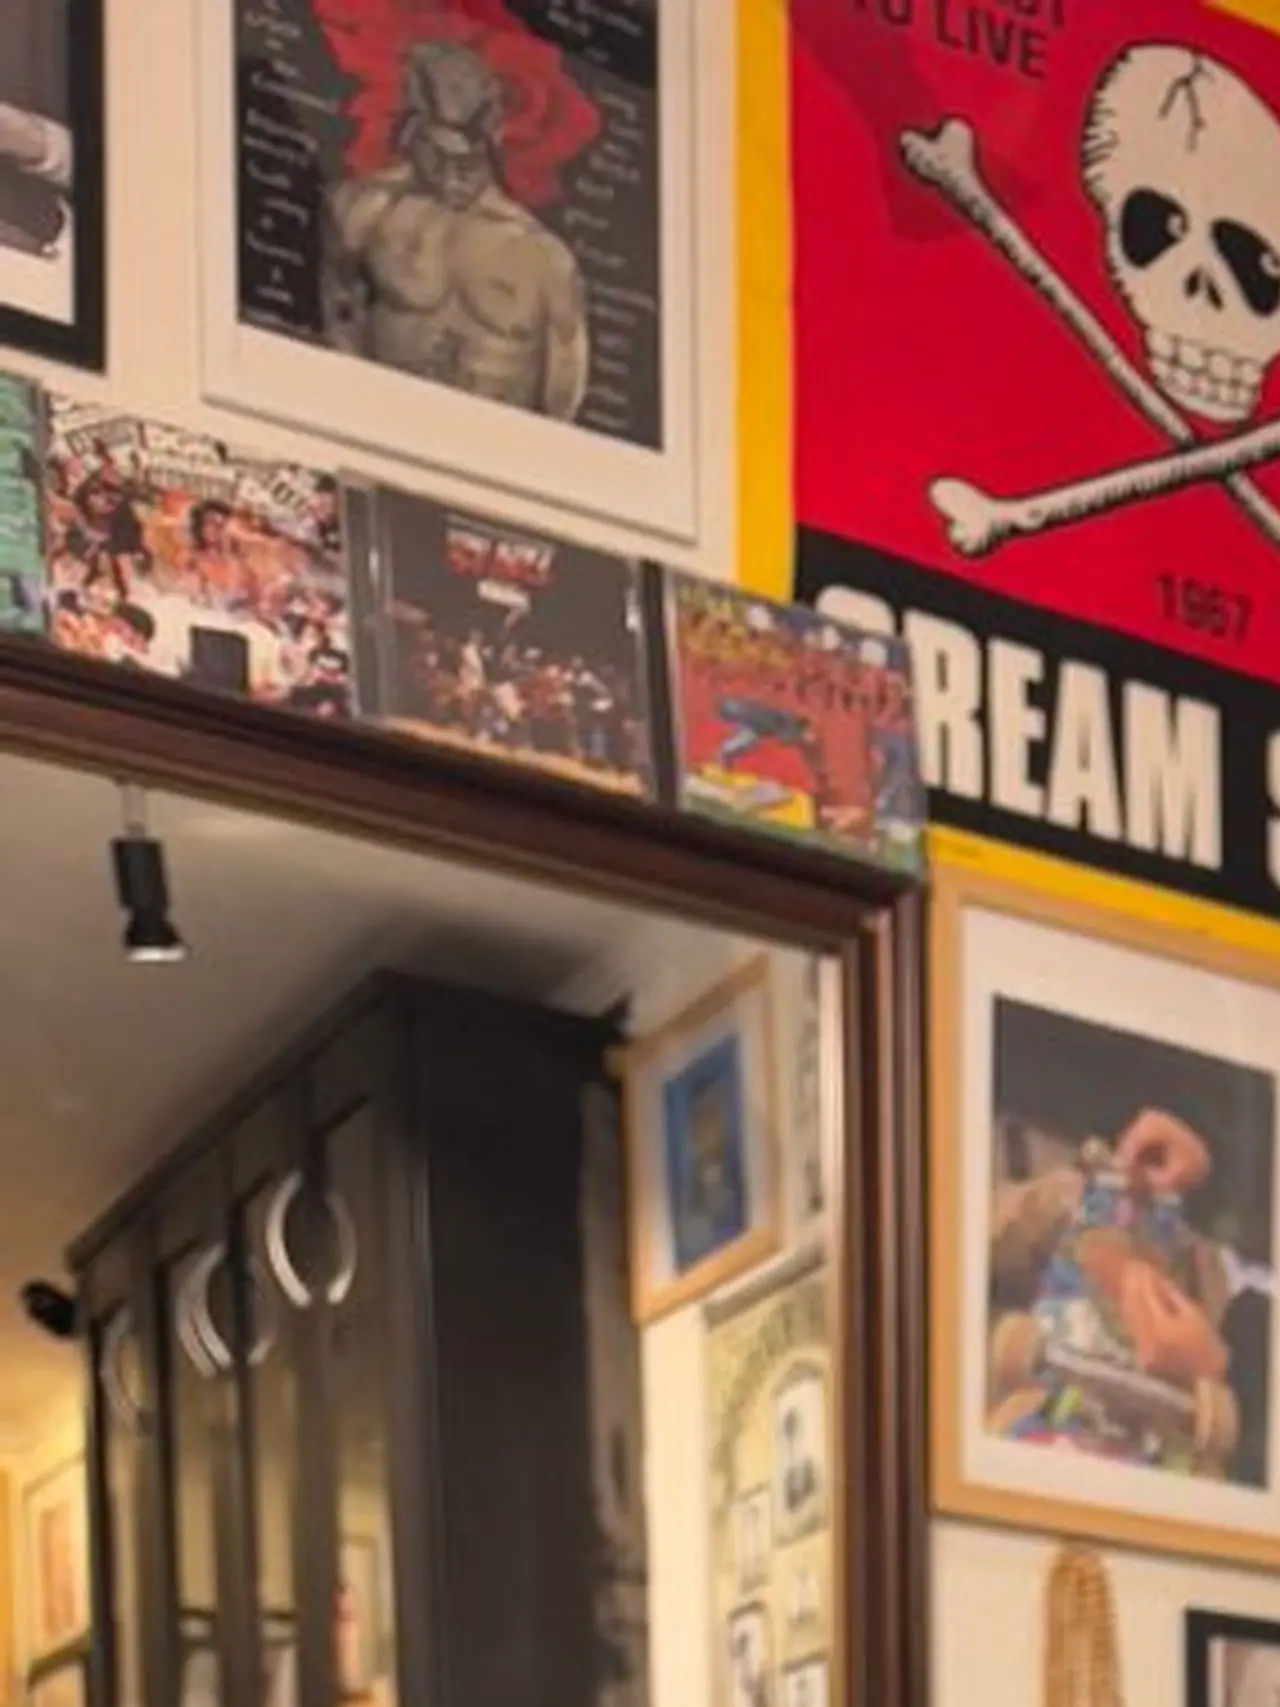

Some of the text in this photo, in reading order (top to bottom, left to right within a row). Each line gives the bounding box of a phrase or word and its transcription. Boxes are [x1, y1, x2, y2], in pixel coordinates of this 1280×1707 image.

[934, 0, 1047, 80] LIVE
[1154, 571, 1255, 646] 1967
[814, 584, 1222, 872] REAM
